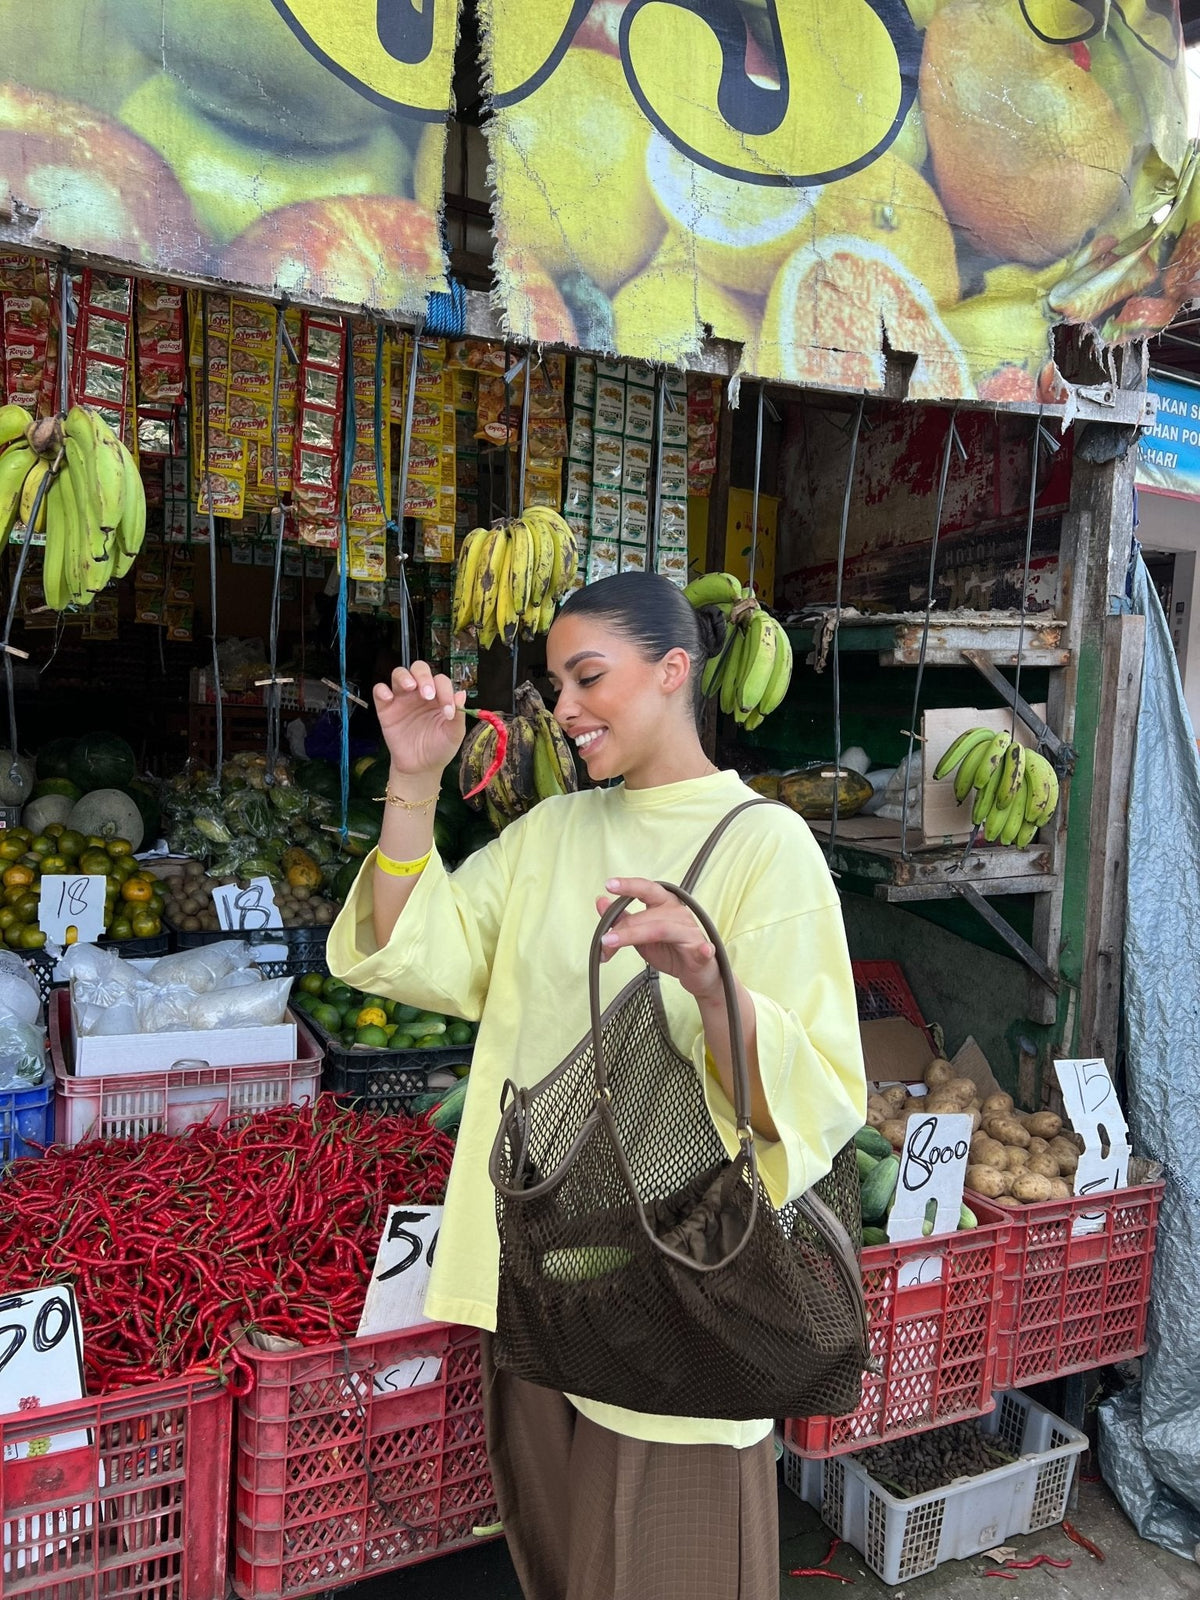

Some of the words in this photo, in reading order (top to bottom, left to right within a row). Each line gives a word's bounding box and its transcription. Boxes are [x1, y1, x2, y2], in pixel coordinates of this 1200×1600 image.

[6, 301, 31, 310] Royco
[235, 330, 271, 342] Masako
[8, 347, 33, 356] Royco
[233, 373, 270, 386] Masako
[11, 393, 35, 403] Royco
[1190, 404, 1200, 421] S
[231, 419, 269, 430] Masako
[352, 505, 383, 516] Masako
[56, 876, 91, 920] 18
[221, 882, 272, 931] 18
[1073, 1061, 1113, 1115] 15
[902, 1116, 968, 1192] 8000
[376, 1210, 441, 1282] 5
